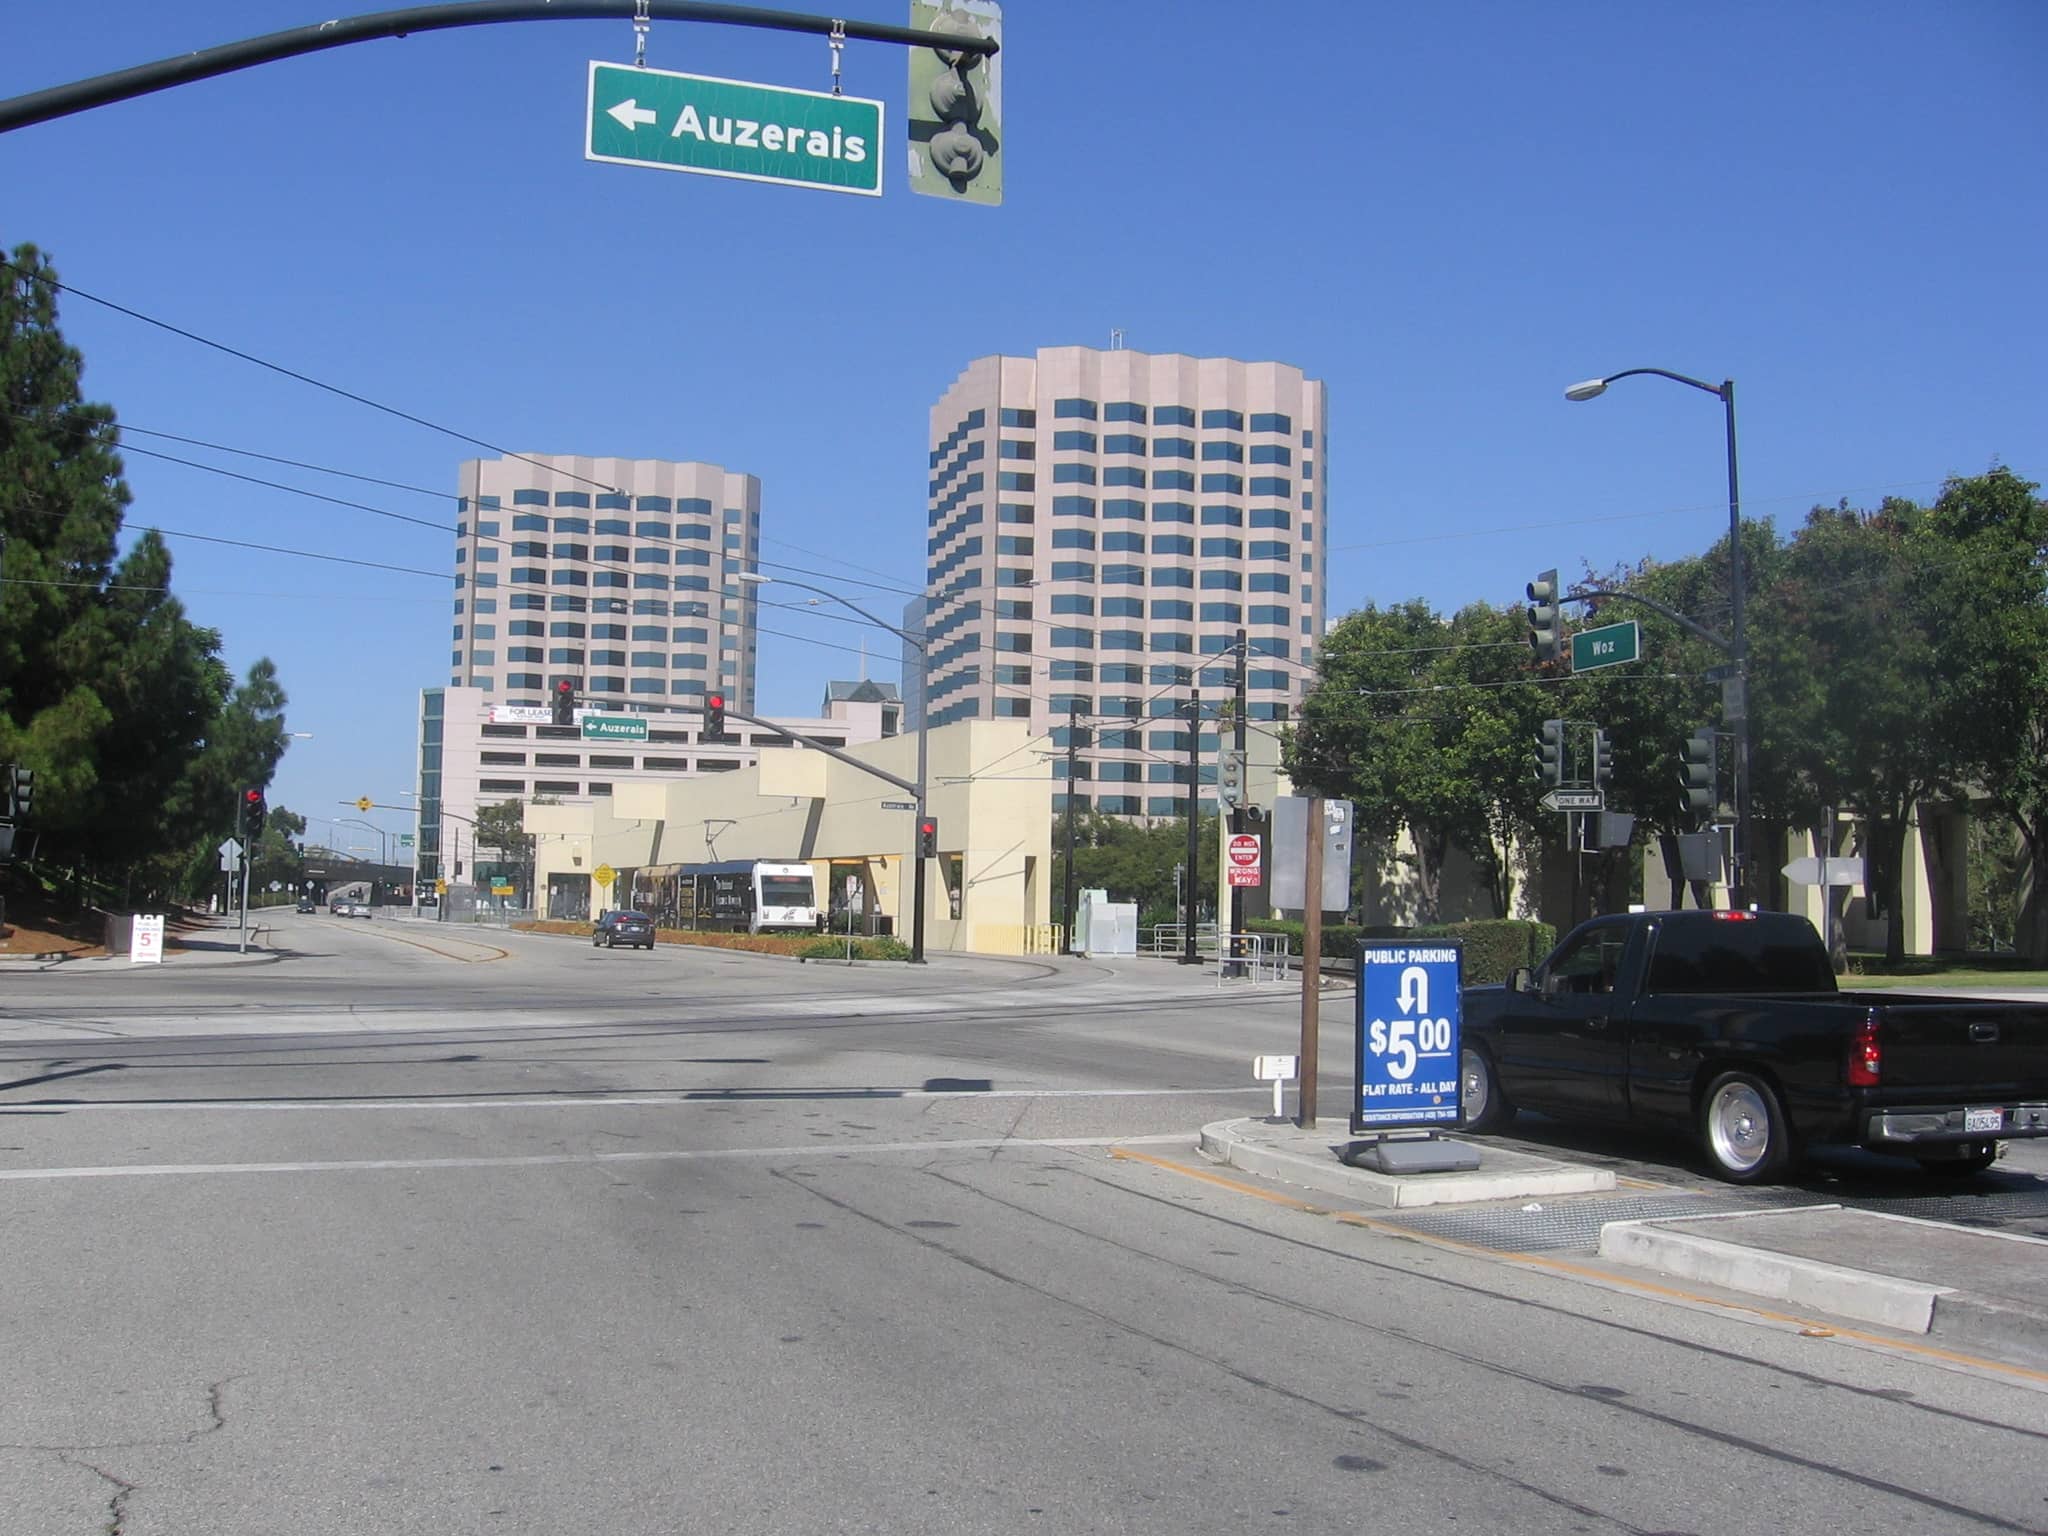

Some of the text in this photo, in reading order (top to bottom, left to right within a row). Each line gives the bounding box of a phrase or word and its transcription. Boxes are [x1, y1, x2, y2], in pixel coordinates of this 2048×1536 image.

[671, 105, 866, 163] Auzerais
[1592, 641, 1615, 656] Woz
[510, 708, 526, 717] FOR
[600, 724, 645, 734] Auzerais
[1559, 797, 1595, 805] ONE WAY
[1365, 949, 1457, 964] PUBLIC PARKING
[1362, 1084, 1387, 1096] FLAT
[1389, 1083, 1413, 1095] RATE
[1420, 1082, 1437, 1094] ALL
[1440, 1081, 1457, 1093] DAY
